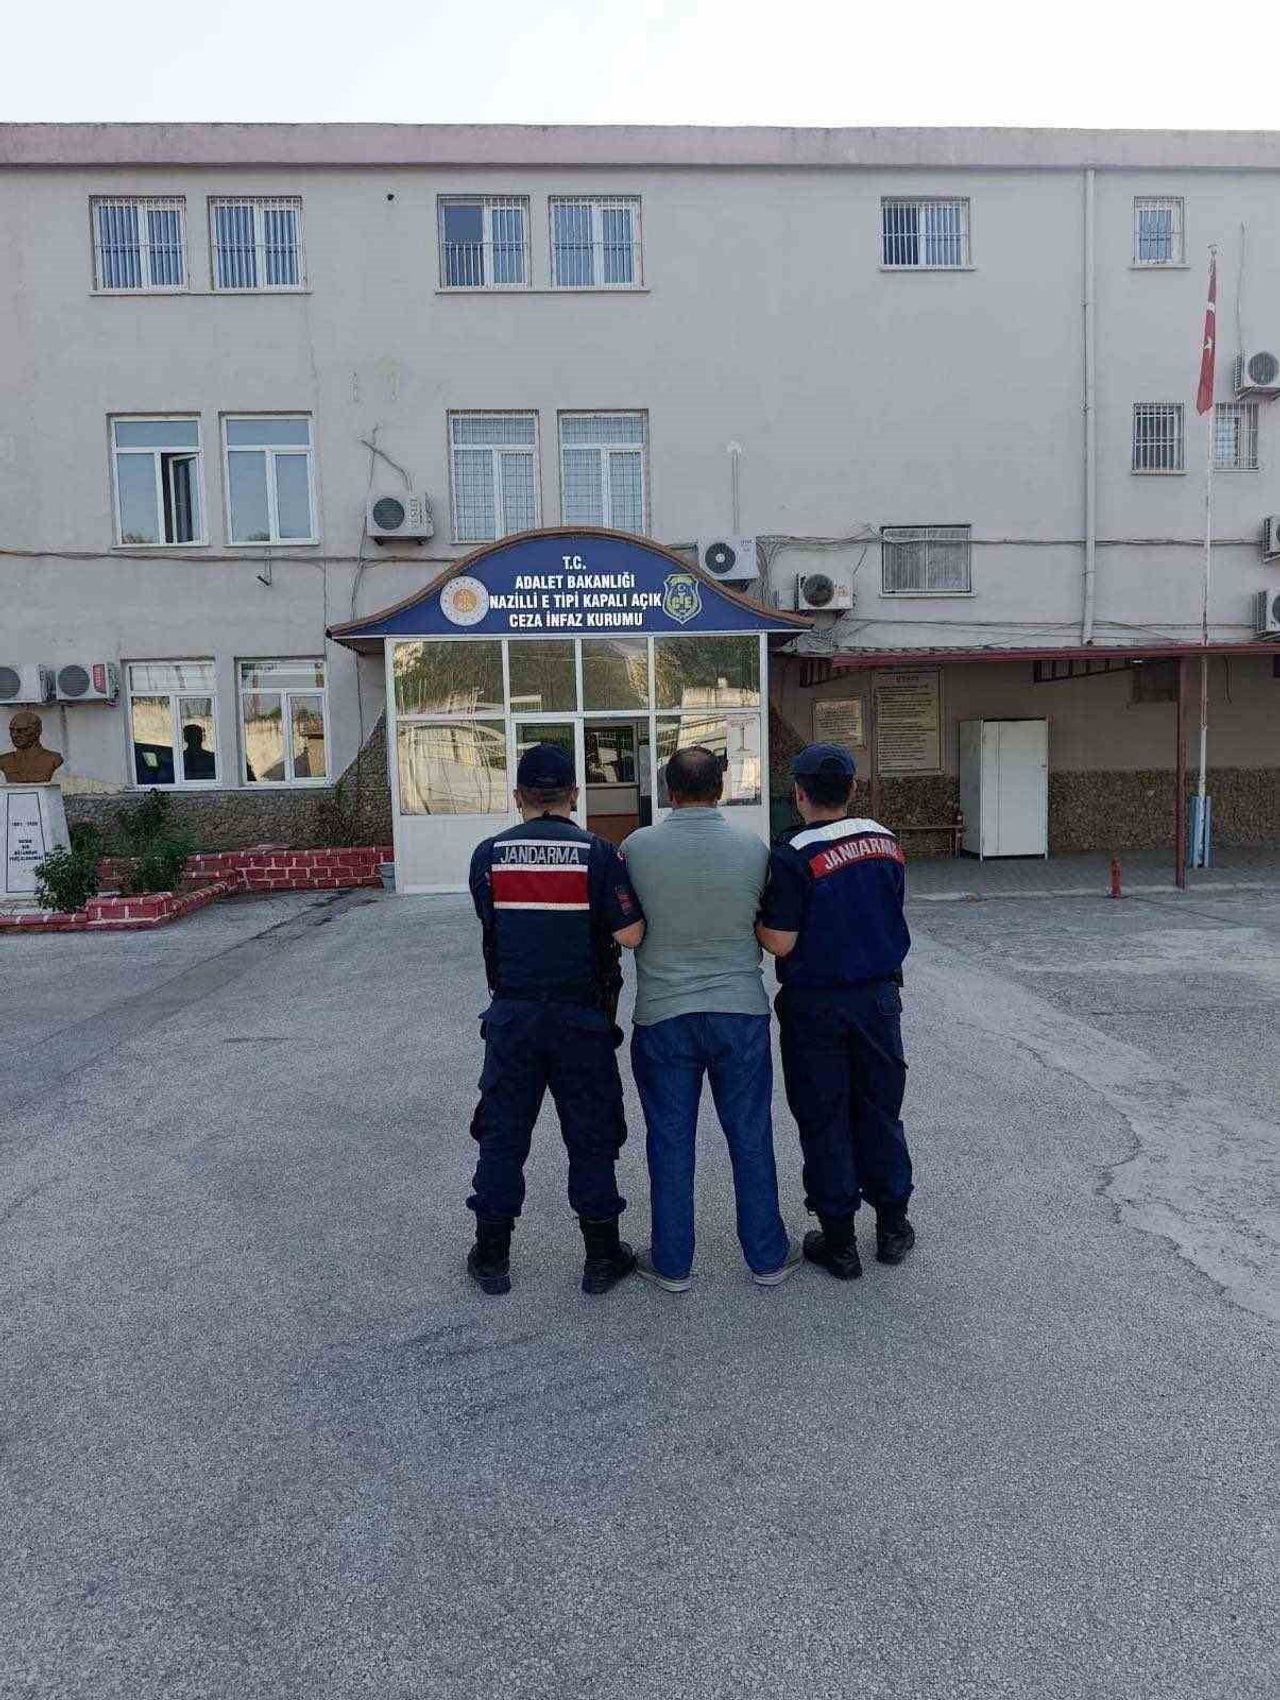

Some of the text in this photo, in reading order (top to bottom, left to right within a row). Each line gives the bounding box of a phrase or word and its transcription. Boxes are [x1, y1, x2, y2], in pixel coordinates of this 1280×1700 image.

[562, 555, 586, 570] T.C.
[515, 571, 635, 589] ADALET BAKANLIĞI
[490, 590, 662, 611] NAZİLLİ E TİPİ KAPALI AÇIK
[509, 610, 644, 628] CEZA İNFAZ KURUMU
[500, 846, 580, 864] JANDARMA
